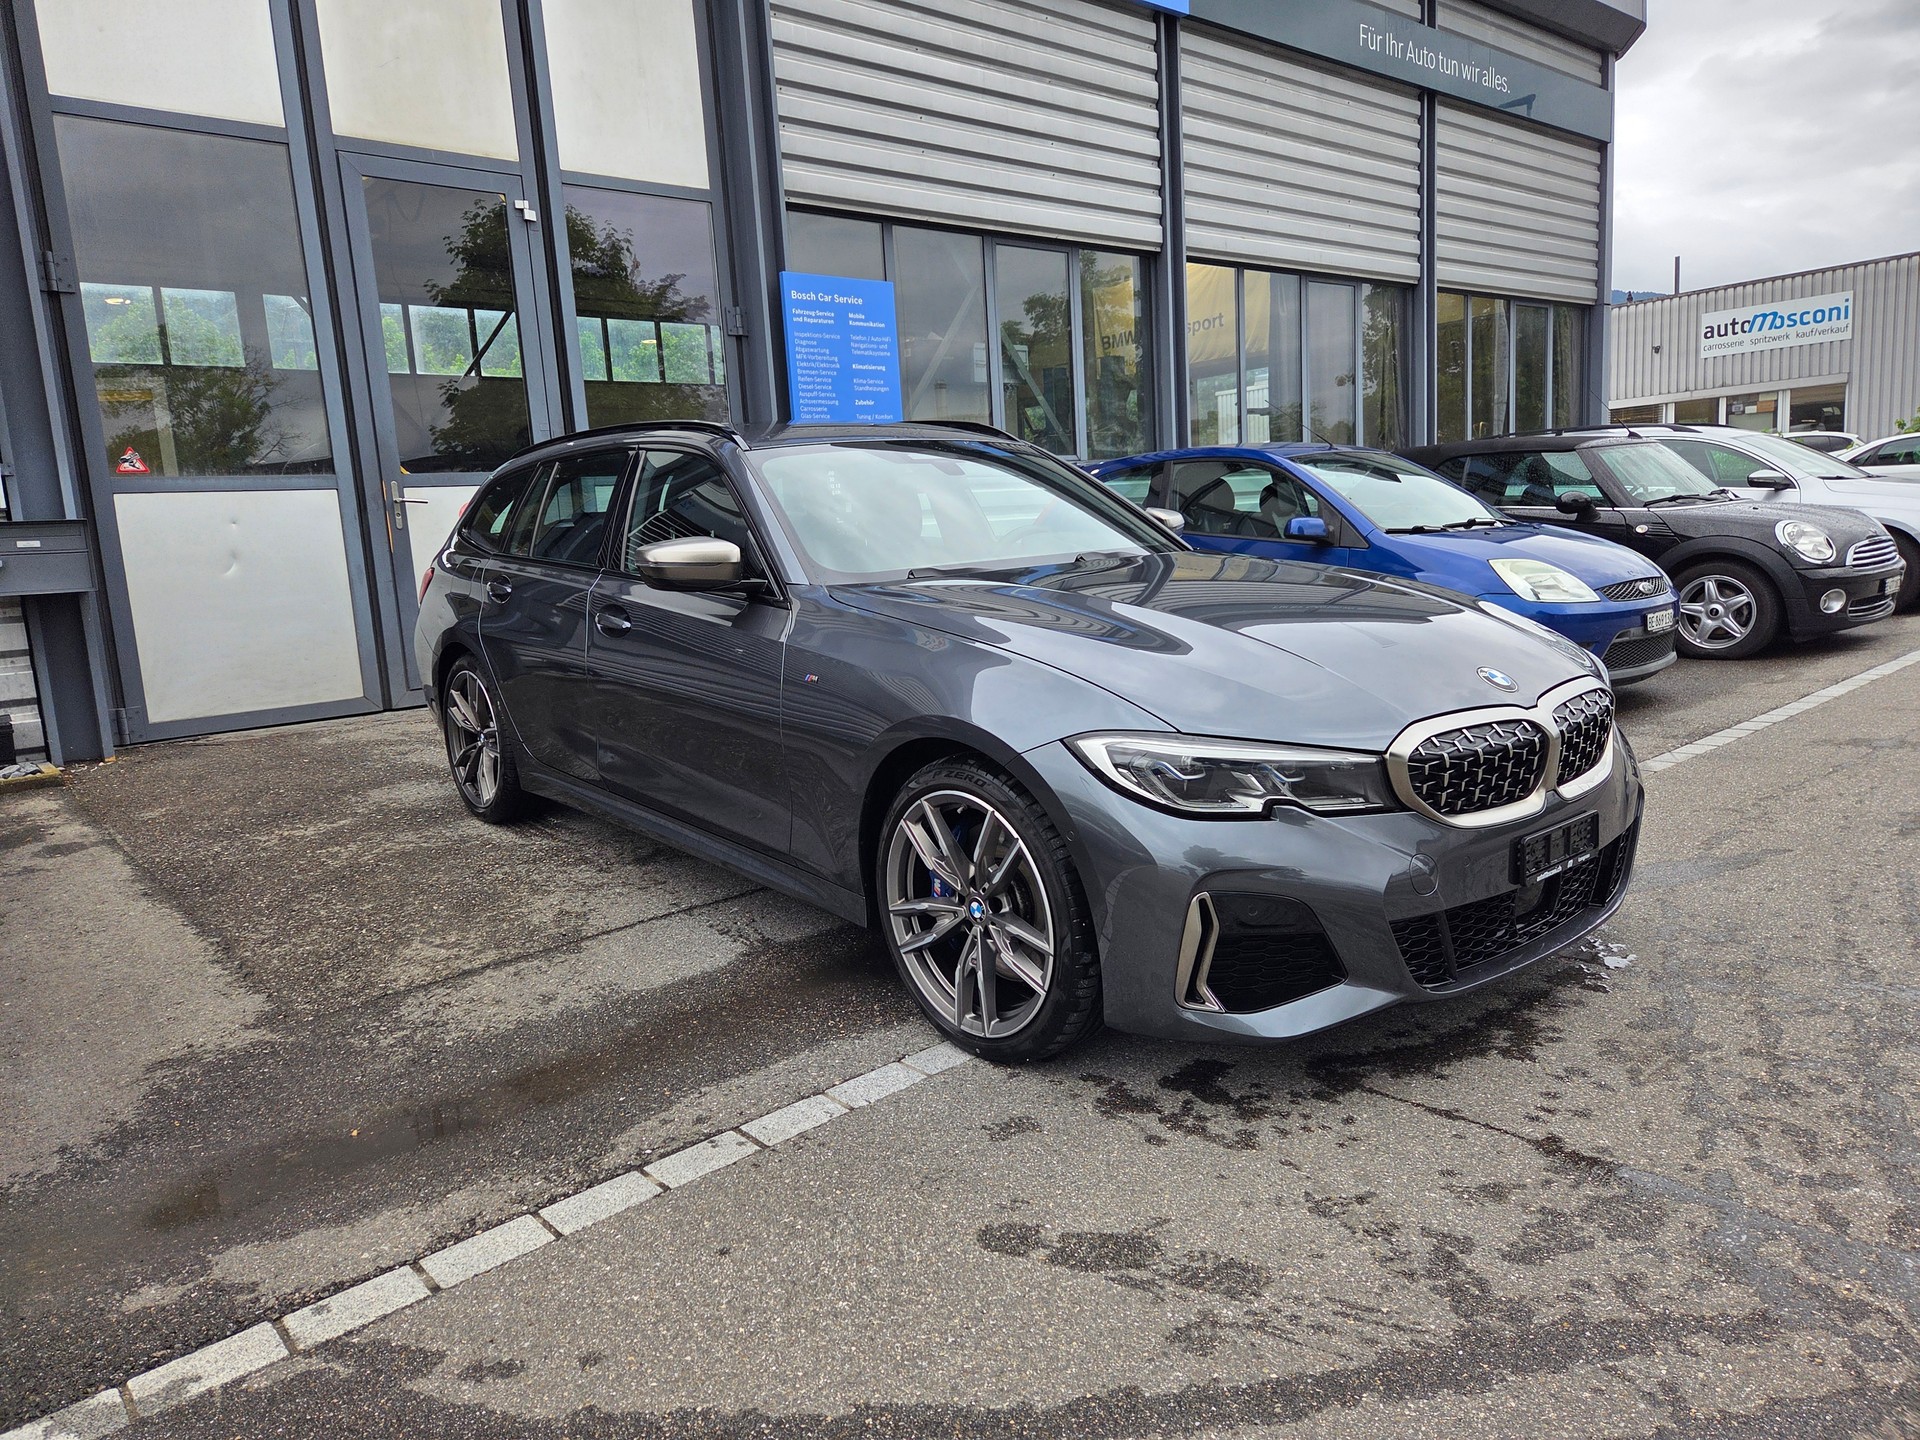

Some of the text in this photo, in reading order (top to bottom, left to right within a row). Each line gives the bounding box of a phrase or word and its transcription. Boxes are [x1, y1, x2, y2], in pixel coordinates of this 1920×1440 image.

[1359, 23, 1512, 94] Für Ihr Auto tun wir alles.
[791, 290, 863, 305] Bosch Car Service
[792, 308, 835, 318] Fahrzeug-Service
[848, 312, 865, 320] Mobile
[803, 316, 835, 325] Reparaturen
[849, 319, 886, 329] Kommunikation
[794, 338, 817, 346] Diagnose
[1101, 329, 1135, 351] BMW
[1703, 322, 1850, 352] carrosserie spritzwerk kauf/verkauf
[852, 363, 886, 372] Klimatisierung
[943, 770, 987, 788] ZERO
